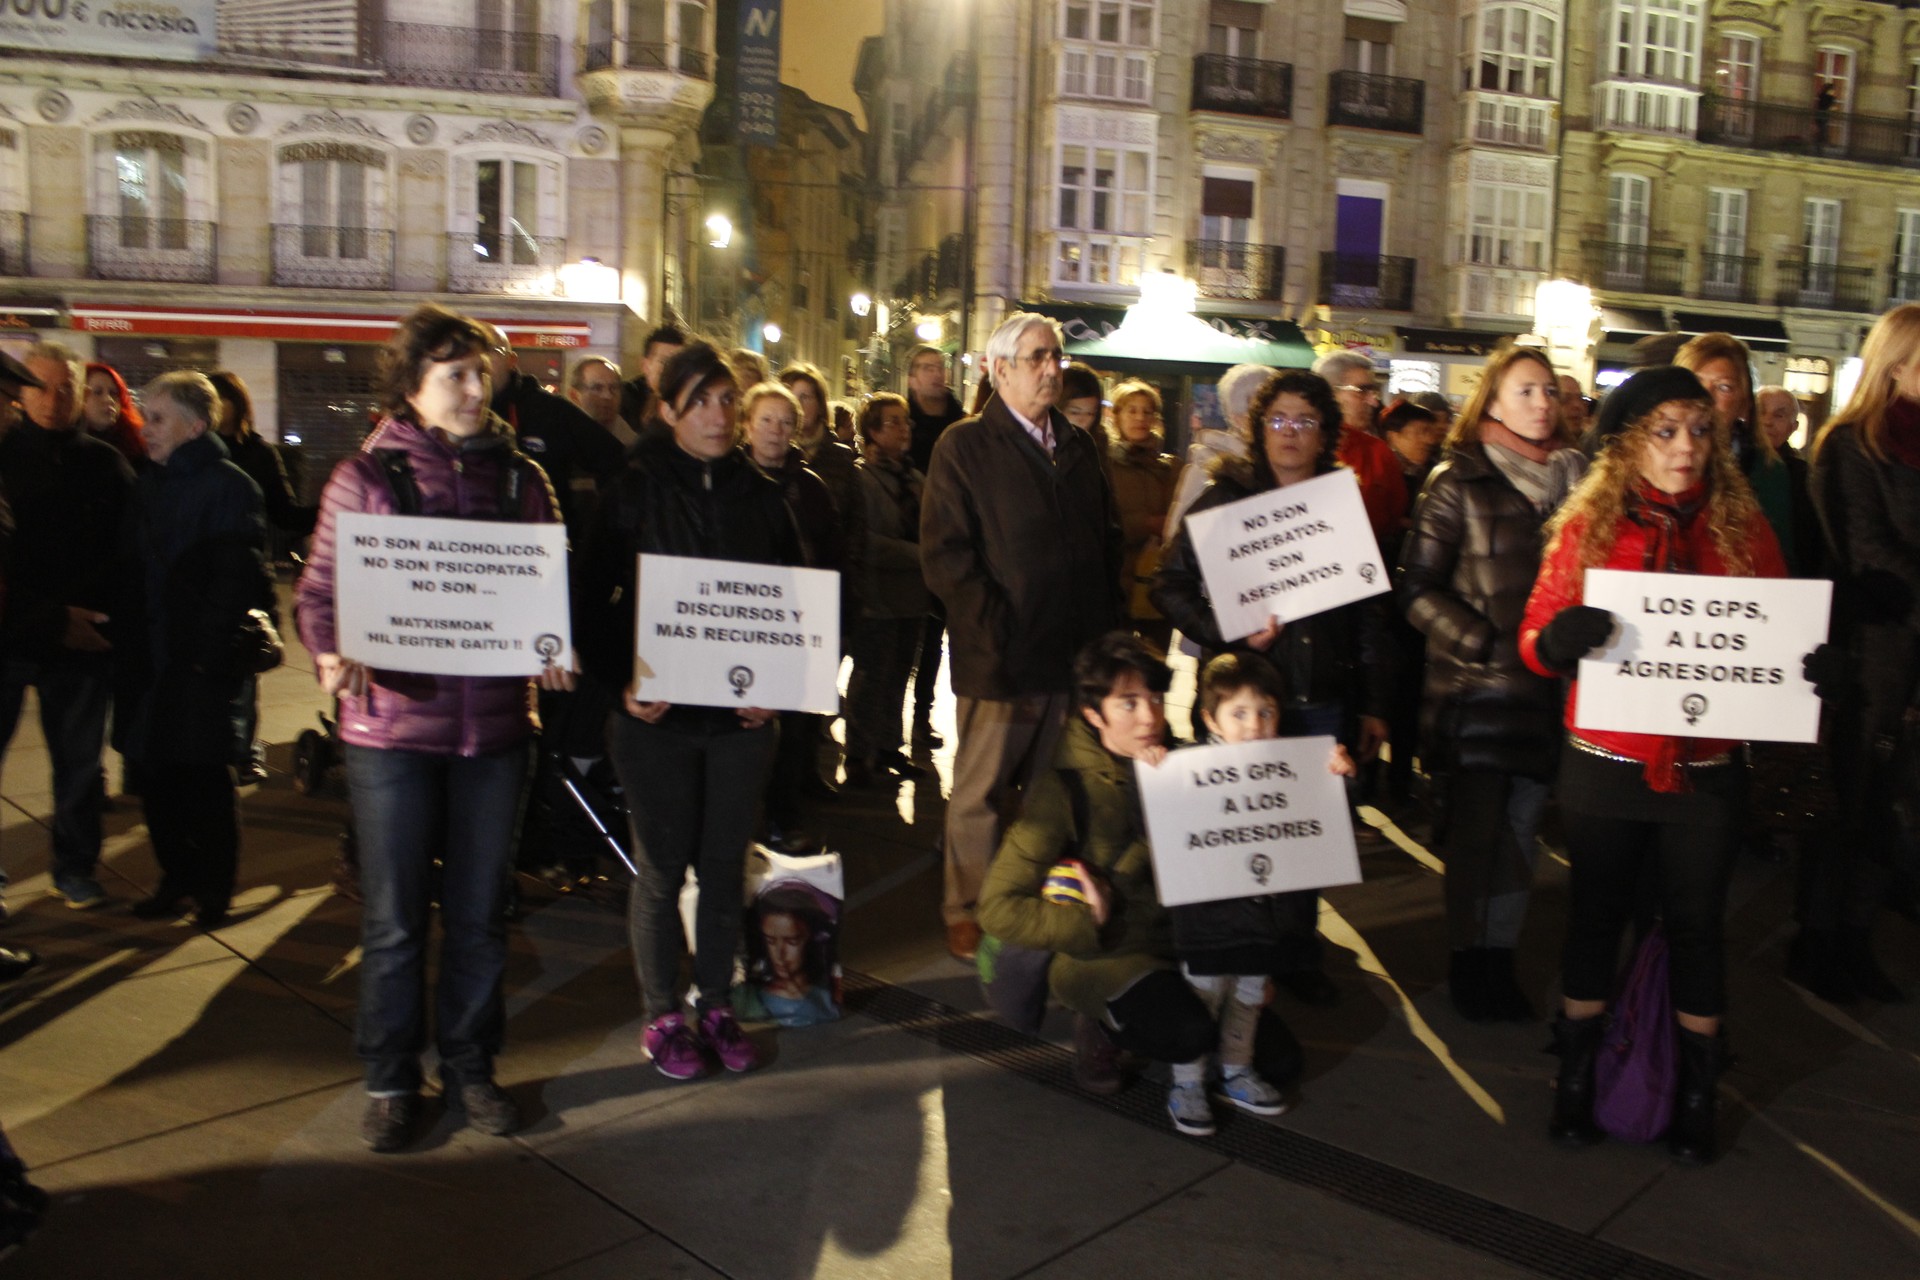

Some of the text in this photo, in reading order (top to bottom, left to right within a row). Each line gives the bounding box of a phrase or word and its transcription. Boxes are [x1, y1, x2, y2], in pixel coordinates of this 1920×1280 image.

[97, 10, 200, 35] nicosia
[744, 7, 777, 37] N
[1242, 502, 1309, 532] NO SON
[353, 535, 551, 558] NO SON ALCOHOLICOS,
[1229, 520, 1335, 562] ARREBATOS,
[363, 556, 543, 578] NO SON PSICOPATAS,
[1266, 551, 1305, 572] SON
[411, 580, 437, 593] NO
[442, 581, 477, 595] SON
[716, 580, 783, 599] MENOS
[1238, 562, 1344, 607] ASESINATOS
[676, 600, 804, 623] DISCURSOS Y
[1642, 596, 1769, 624] LOS GPS,
[389, 616, 495, 632] MATXISMOAK
[656, 621, 697, 640] MÁS
[704, 627, 806, 648] RECURSOS
[367, 631, 394, 646] HIL
[398, 633, 456, 650] EGITEN
[461, 635, 509, 651] GAITU
[1666, 631, 1748, 651] A LOS
[1617, 660, 1785, 686] AGRESORES
[1193, 760, 1298, 788] LOS GPS,
[1223, 792, 1289, 815] A LOS
[1188, 819, 1324, 850] AGRESORES
